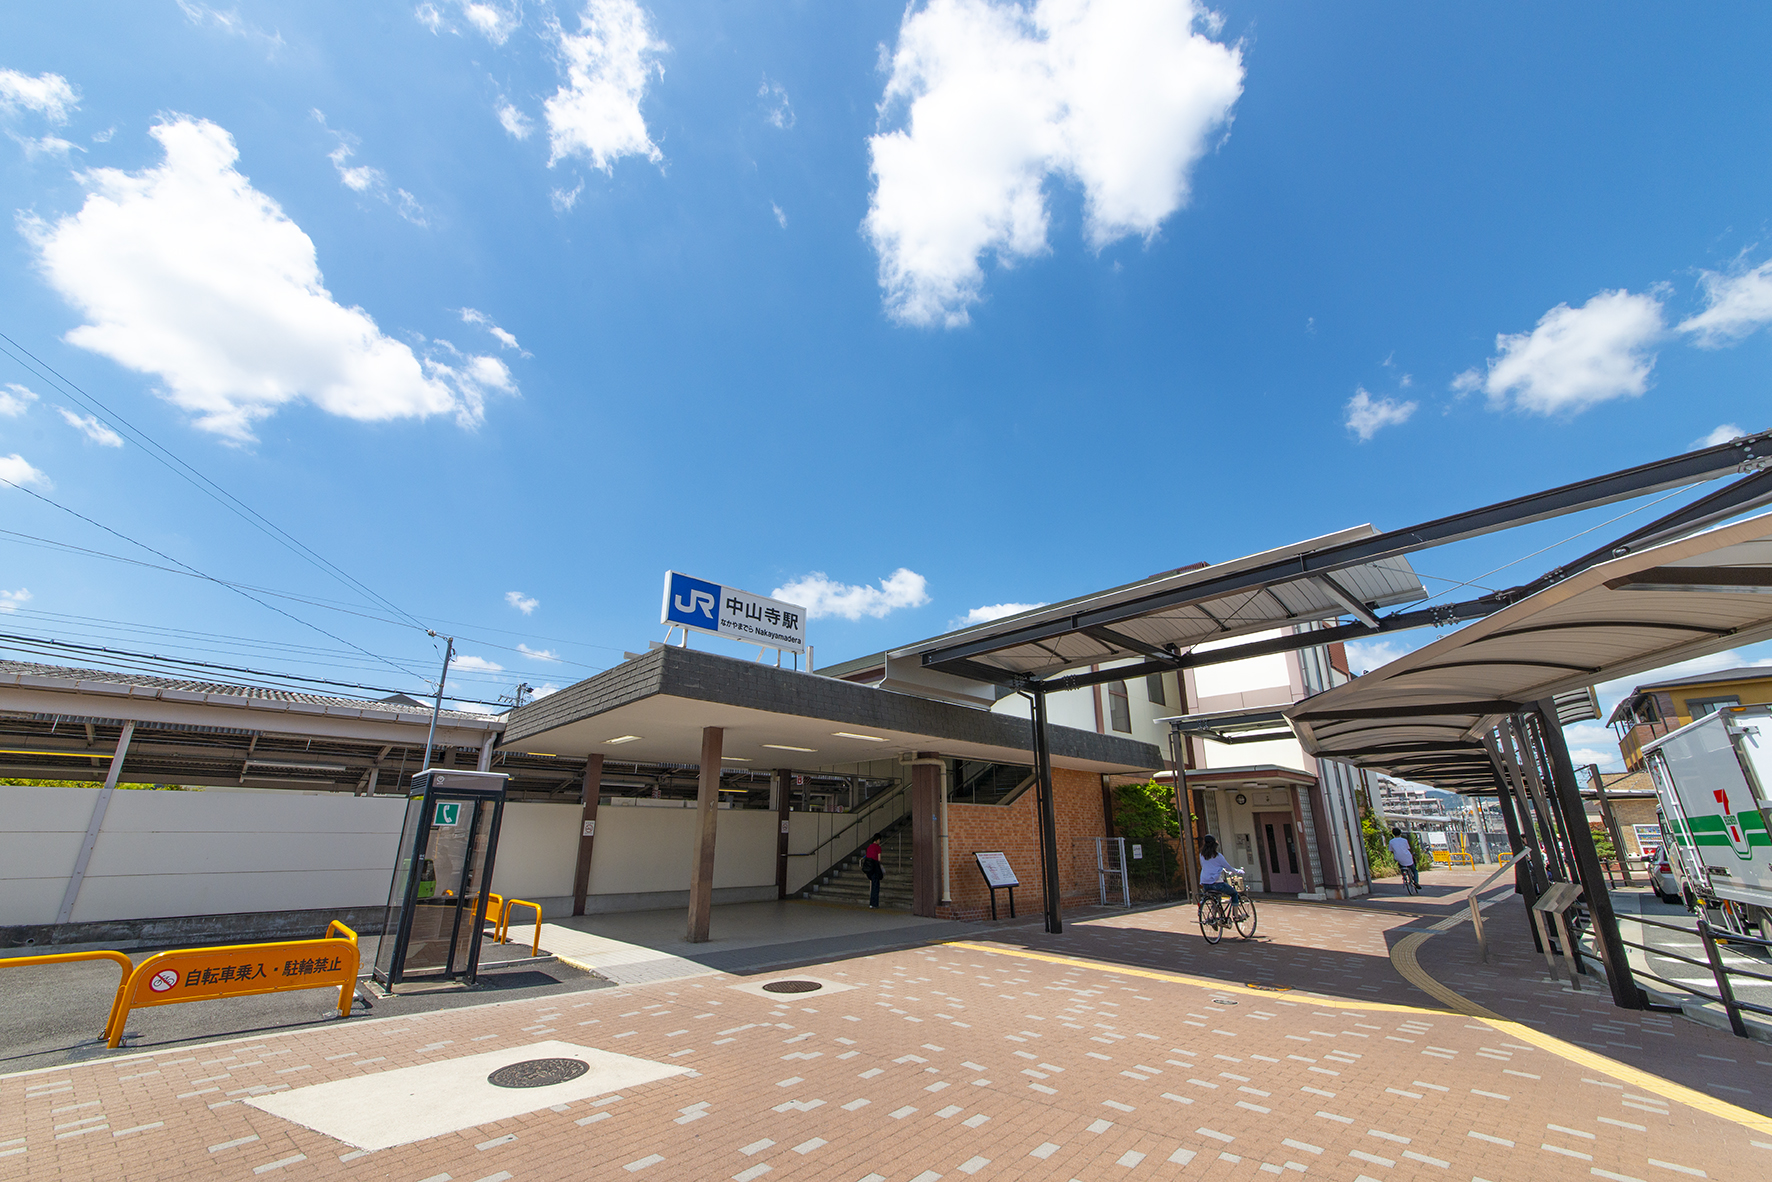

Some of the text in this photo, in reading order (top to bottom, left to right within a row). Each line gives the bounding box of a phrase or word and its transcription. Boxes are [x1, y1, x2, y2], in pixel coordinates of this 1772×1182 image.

[674, 589, 715, 619] JR
[726, 597, 799, 630] 中山寺駅
[720, 619, 802, 645] なかやまでら Nakayamadera
[184, 957, 342, 987] 自転車乗入・駐輪禁止
